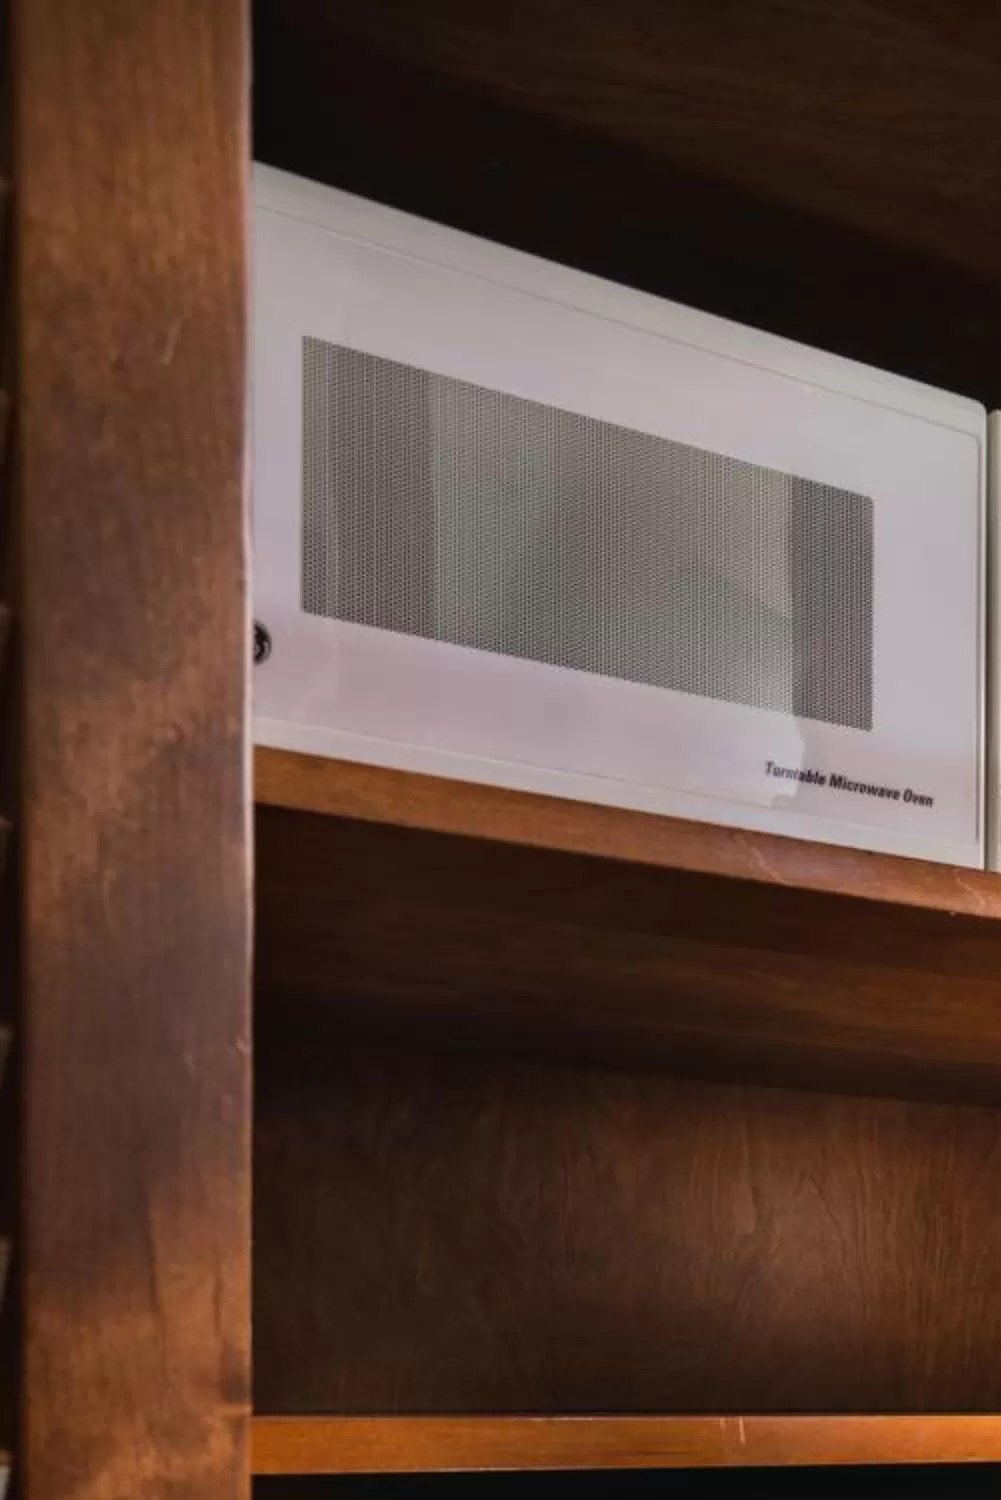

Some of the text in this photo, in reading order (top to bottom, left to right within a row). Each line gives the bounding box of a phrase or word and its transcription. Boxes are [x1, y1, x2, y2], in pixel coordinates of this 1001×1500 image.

[765, 760, 935, 808] Turntable Microwave Oven
